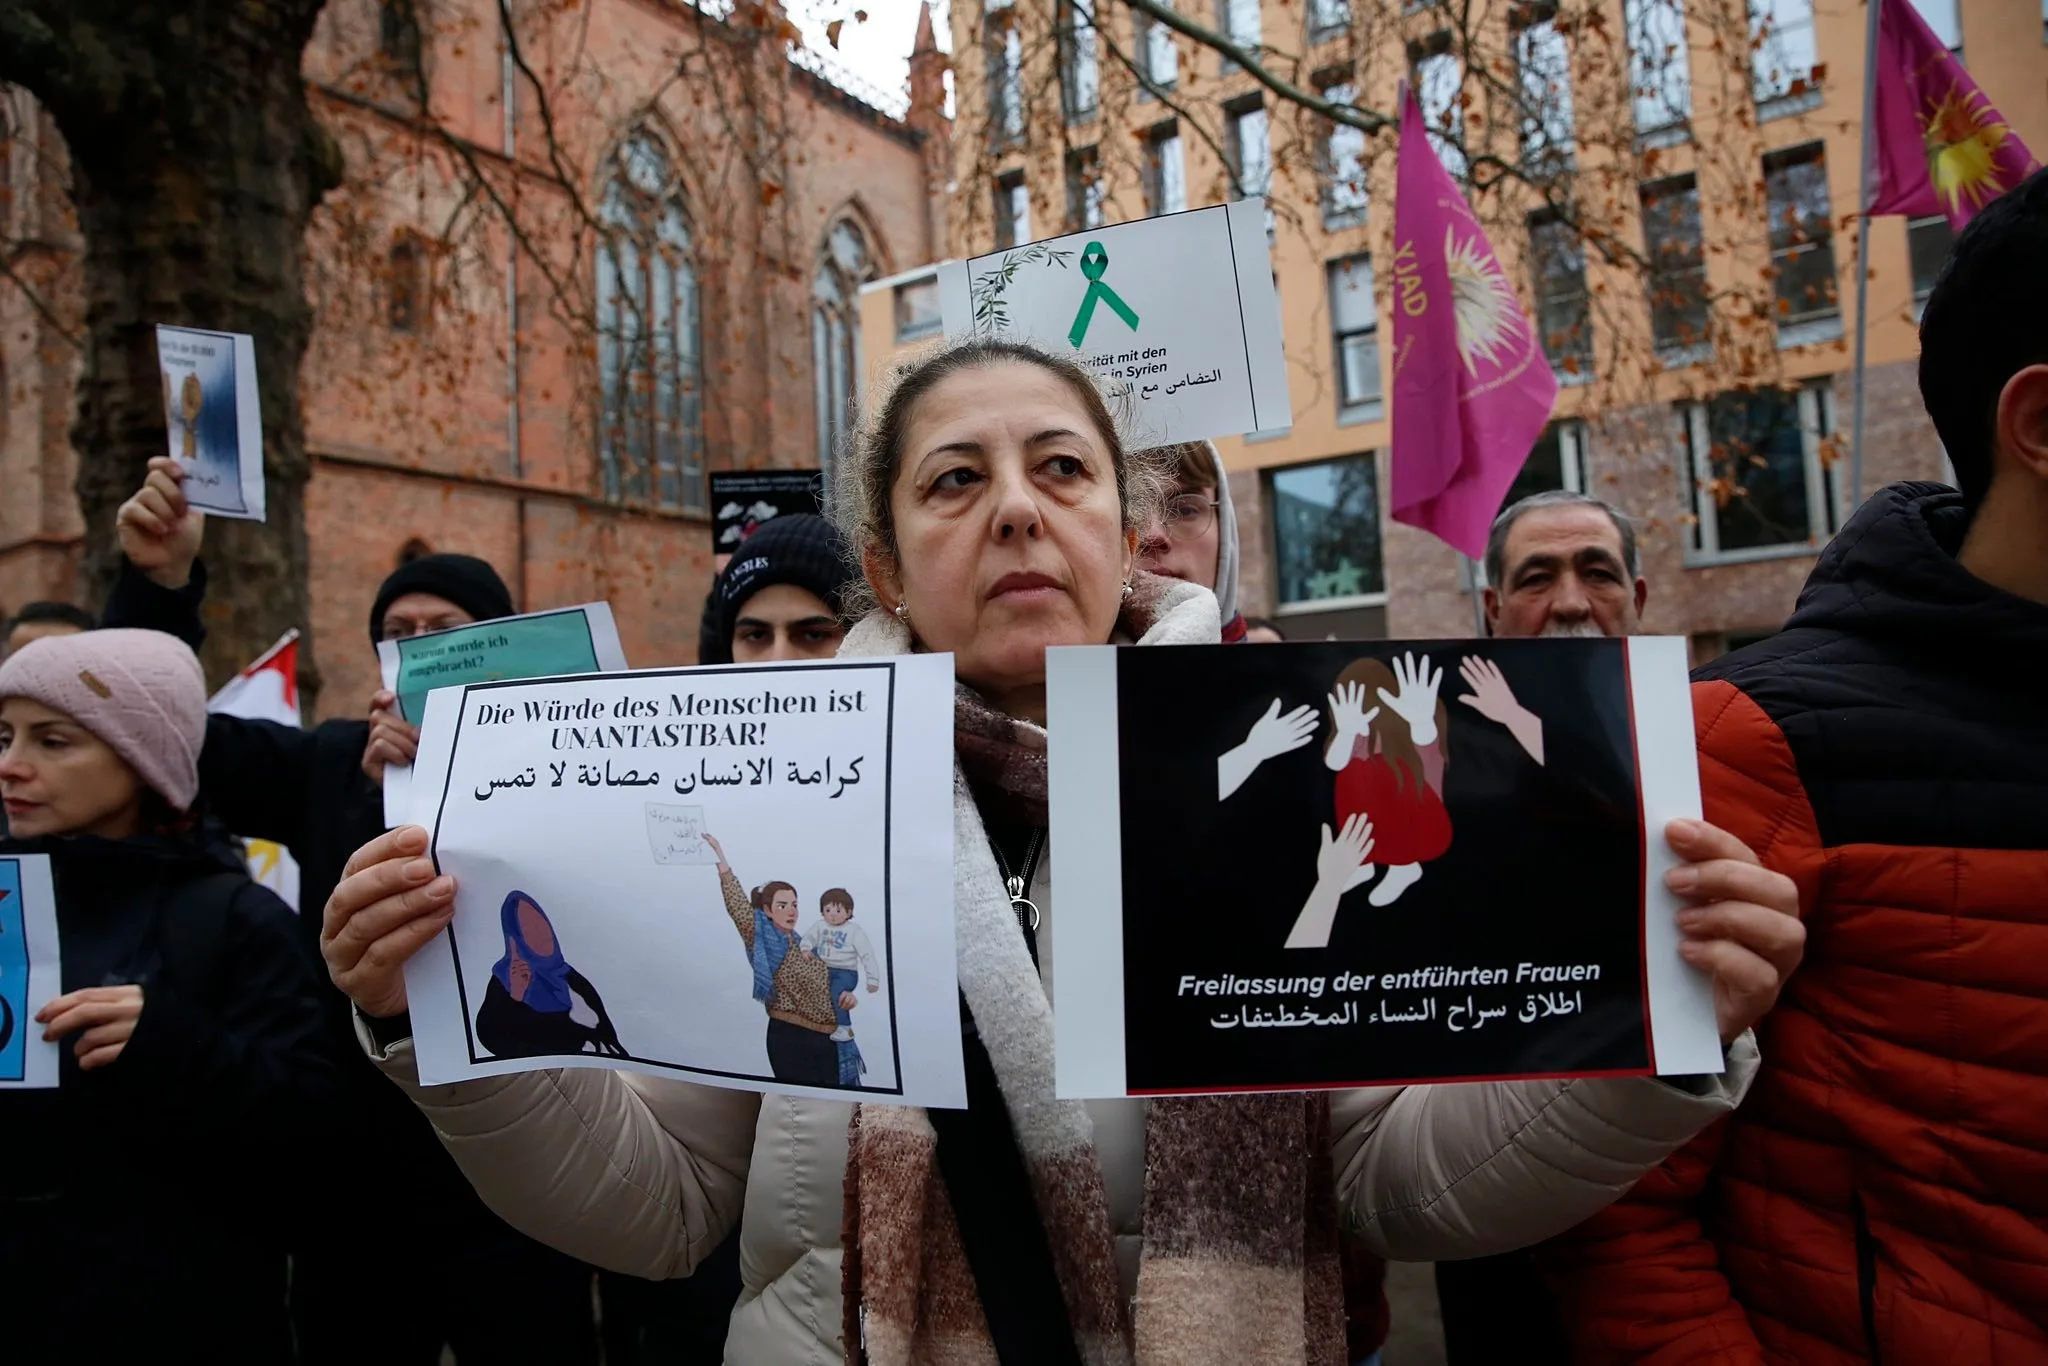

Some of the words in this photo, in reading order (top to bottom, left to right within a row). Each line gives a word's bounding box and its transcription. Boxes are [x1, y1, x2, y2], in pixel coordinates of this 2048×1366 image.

[1117, 349, 1139, 364] mit
[1141, 347, 1167, 361] den
[1111, 368, 1123, 379] in
[1126, 362, 1168, 379] Syrien
[1165, 368, 1222, 395] التضامن
[1140, 382, 1159, 400] مع
[488, 634, 509, 649] ich
[476, 703, 516, 726] Die
[523, 697, 606, 724] Würde
[613, 696, 660, 719] des
[667, 690, 818, 717] Menschen
[828, 689, 868, 713] ist
[550, 721, 768, 751] UNANTASTBAR!
[473, 766, 537, 802] تمس
[549, 760, 567, 788] لا
[576, 759, 661, 788] مصانة
[674, 755, 774, 796] الانسان
[786, 755, 865, 799] كرامة
[1177, 973, 1327, 998] Freilassung
[1332, 970, 1376, 992] der
[1380, 965, 1509, 991] entführten
[1515, 962, 1602, 984] Frauen
[1368, 996, 1437, 1024] النساء
[1447, 995, 1508, 1032] سراح
[1518, 990, 1582, 1024] اطلاق
